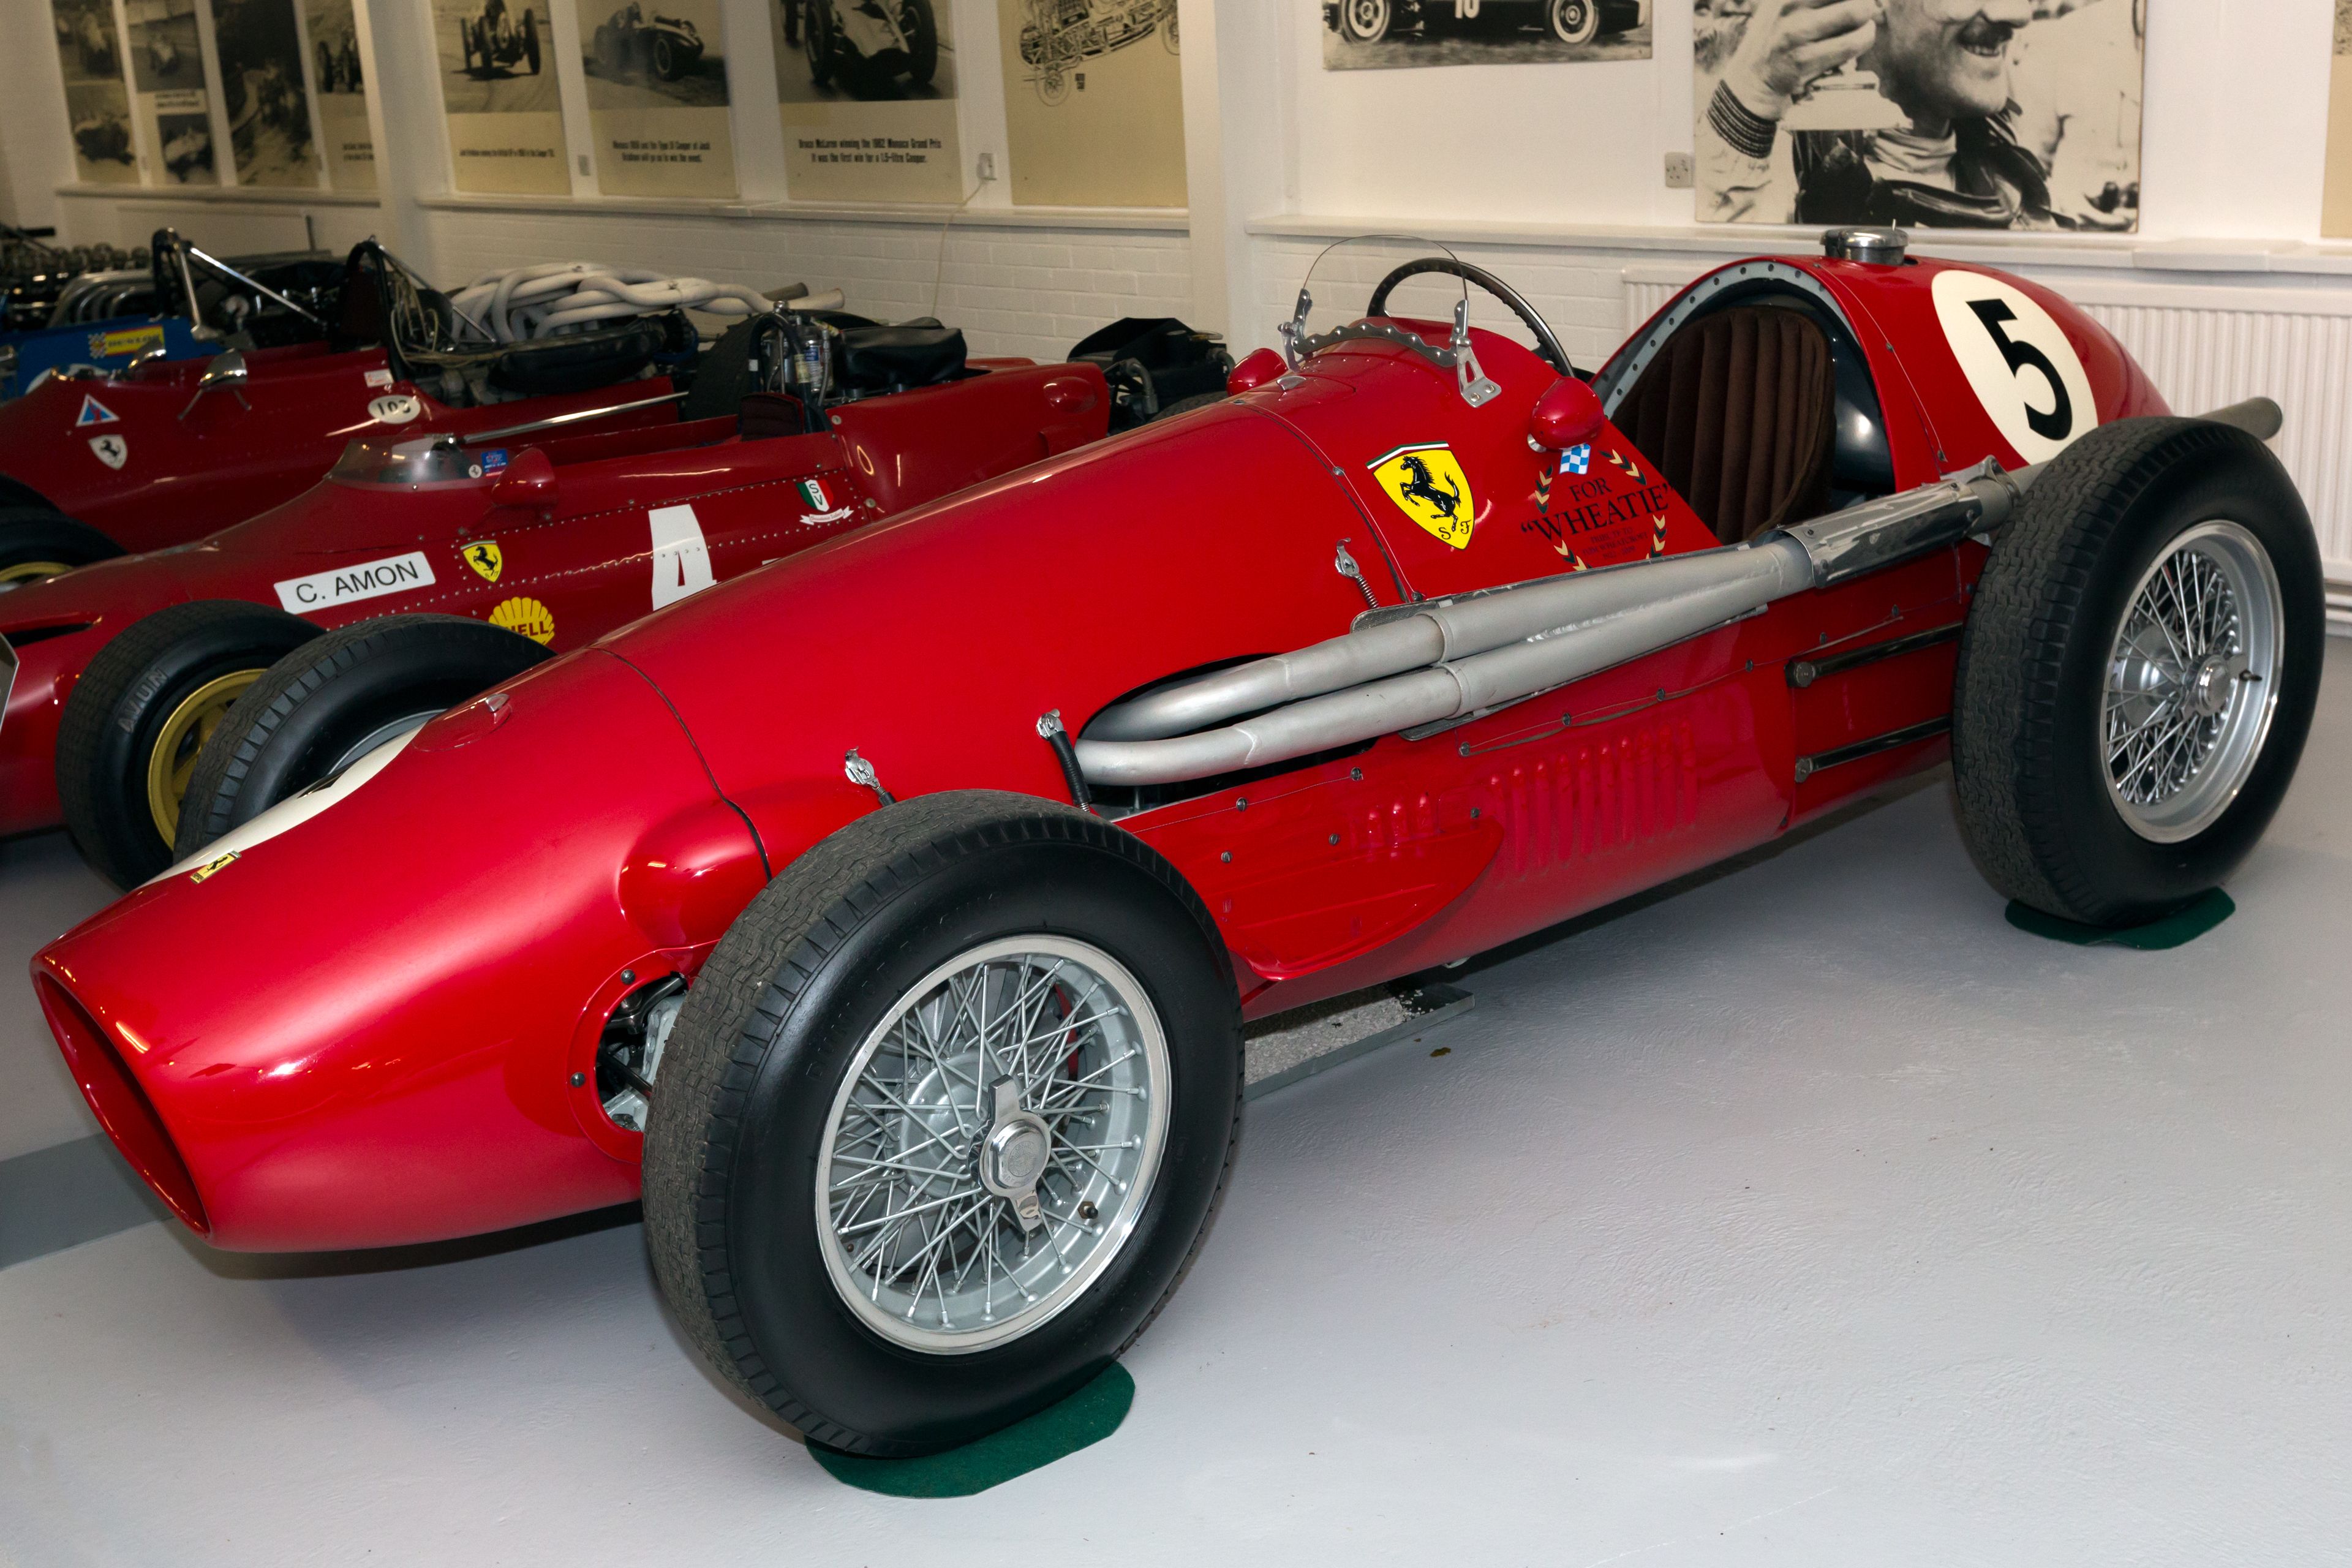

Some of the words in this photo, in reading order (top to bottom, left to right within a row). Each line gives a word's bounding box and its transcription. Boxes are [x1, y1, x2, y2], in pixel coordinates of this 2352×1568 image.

[1966, 298, 2073, 441] 5
[1569, 477, 1613, 502] FOR
[1438, 527, 1452, 540] S
[296, 583, 326, 603] C.
[336, 560, 419, 597] AMON
